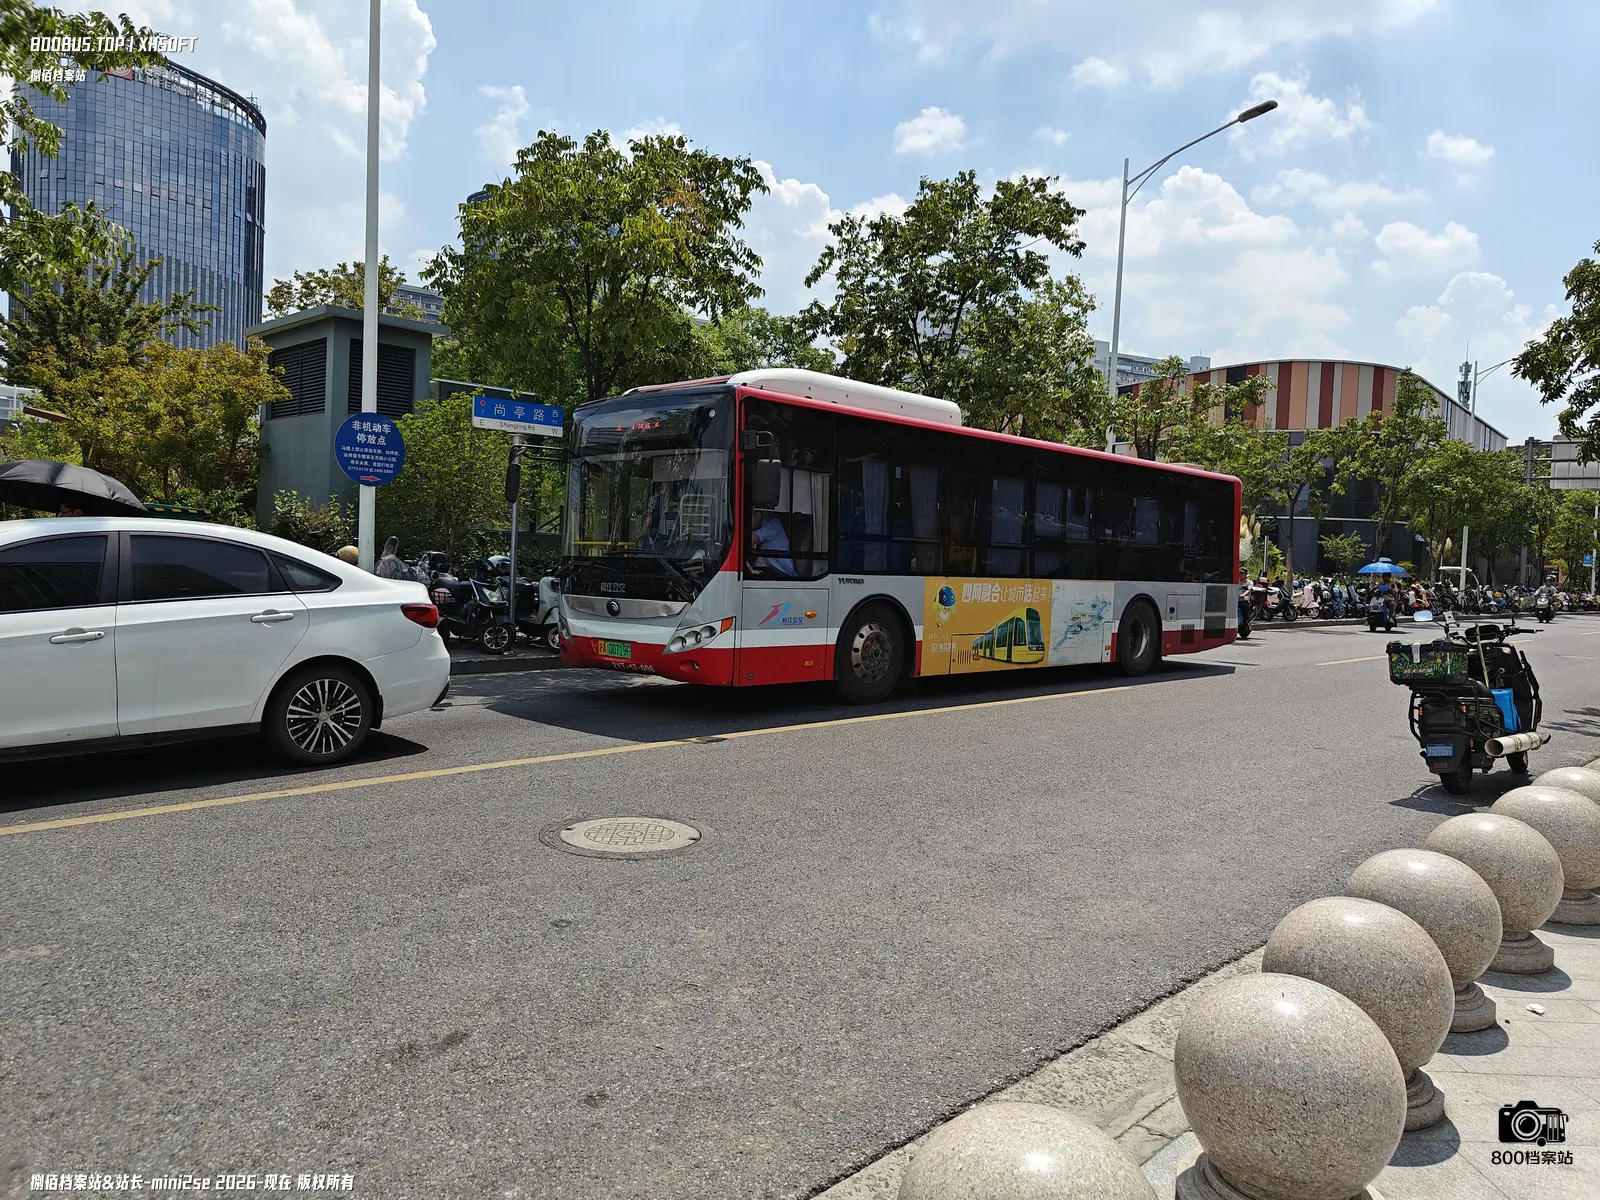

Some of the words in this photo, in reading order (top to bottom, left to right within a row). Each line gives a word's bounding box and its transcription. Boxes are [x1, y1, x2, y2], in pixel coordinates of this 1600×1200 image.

[494, 403, 545, 422] 尚亭路
[352, 420, 391, 434] 非机动车
[500, 421, 527, 432] Shangting
[551, 427, 559, 435] W
[356, 432, 387, 446] 停放点
